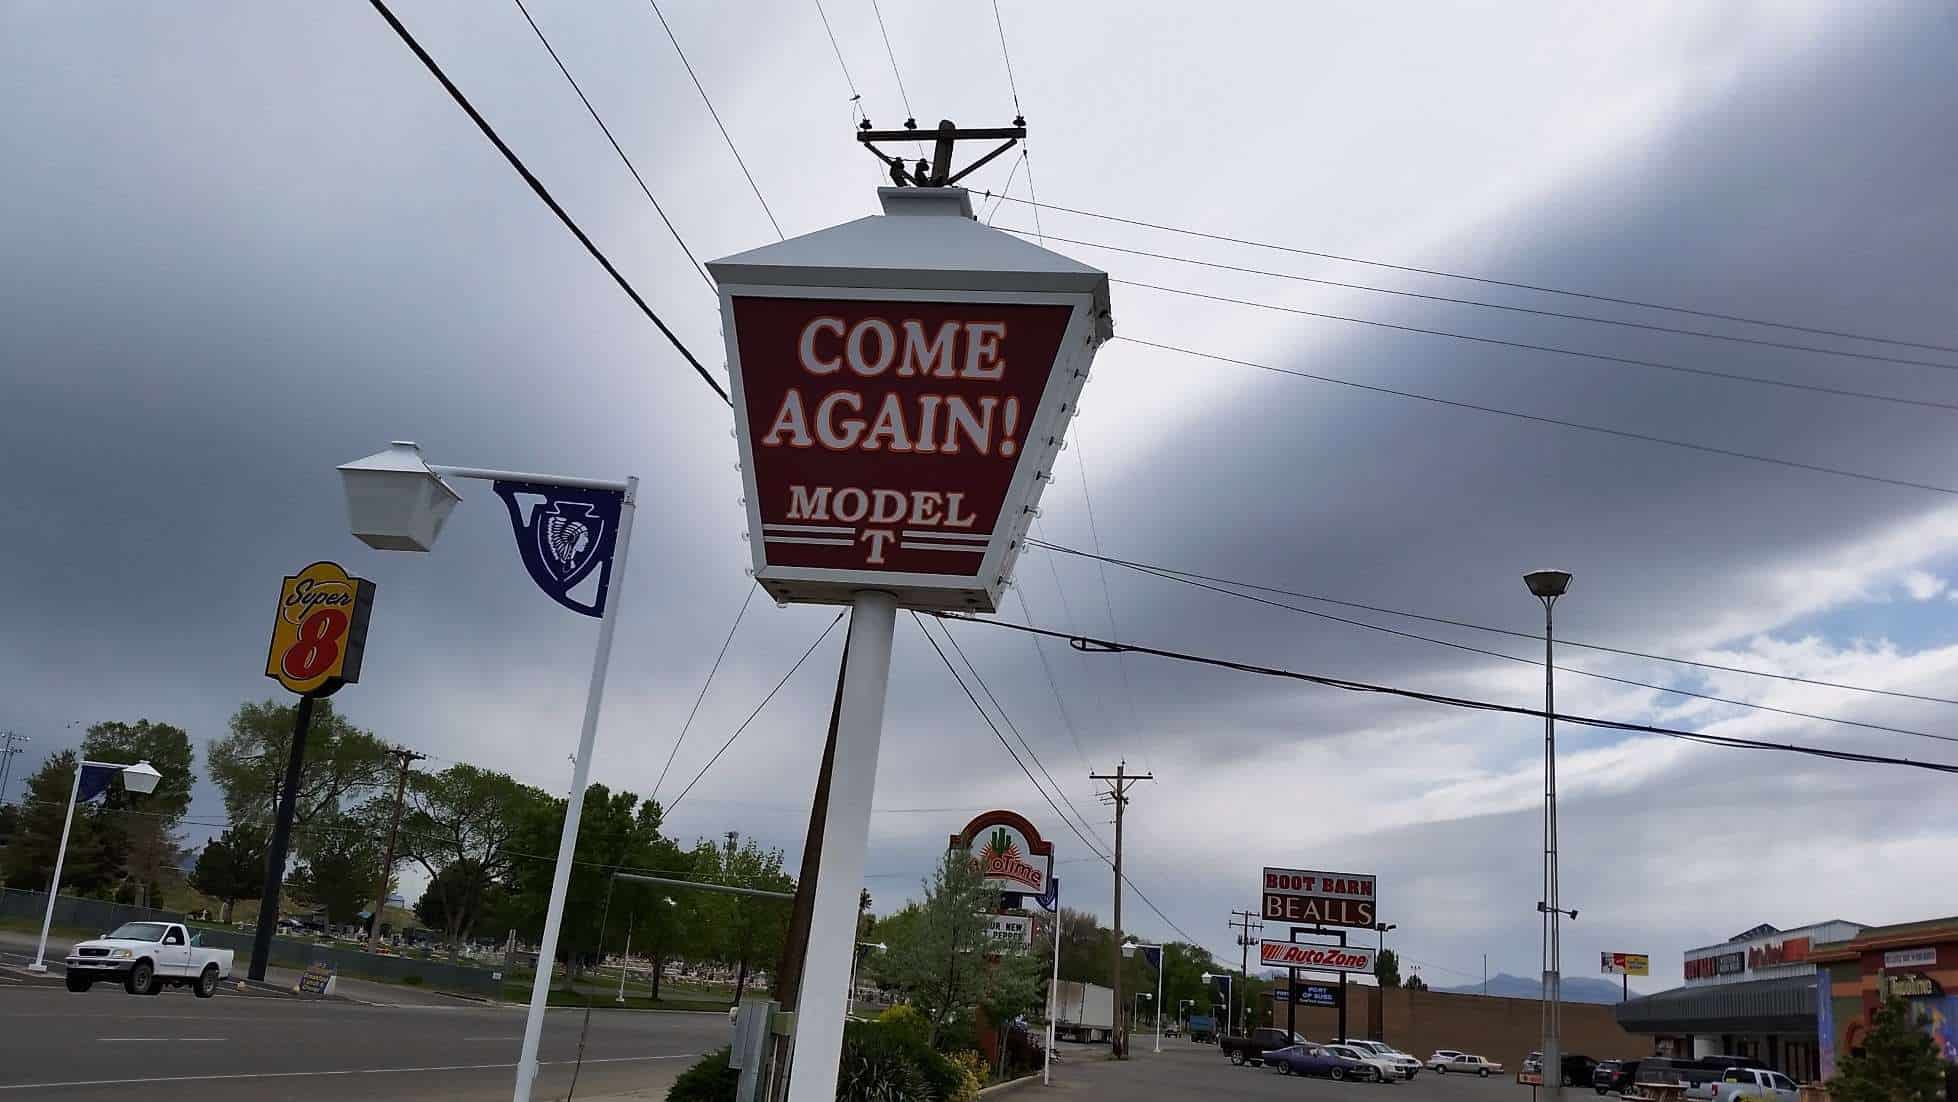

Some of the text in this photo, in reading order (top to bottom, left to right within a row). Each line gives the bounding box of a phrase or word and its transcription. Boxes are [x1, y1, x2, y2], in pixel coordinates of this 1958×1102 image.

[799, 317, 1007, 380] COME
[762, 388, 1021, 458] AGAIN!
[785, 485, 977, 528] MODEL
[861, 529, 896, 564] T
[285, 578, 352, 619] Super
[281, 608, 349, 681] 8
[958, 855, 1041, 883] oTime
[1266, 873, 1373, 897] BOOT BARN
[1266, 896, 1372, 926] BEALLS
[1284, 947, 1369, 969] AutoZone
